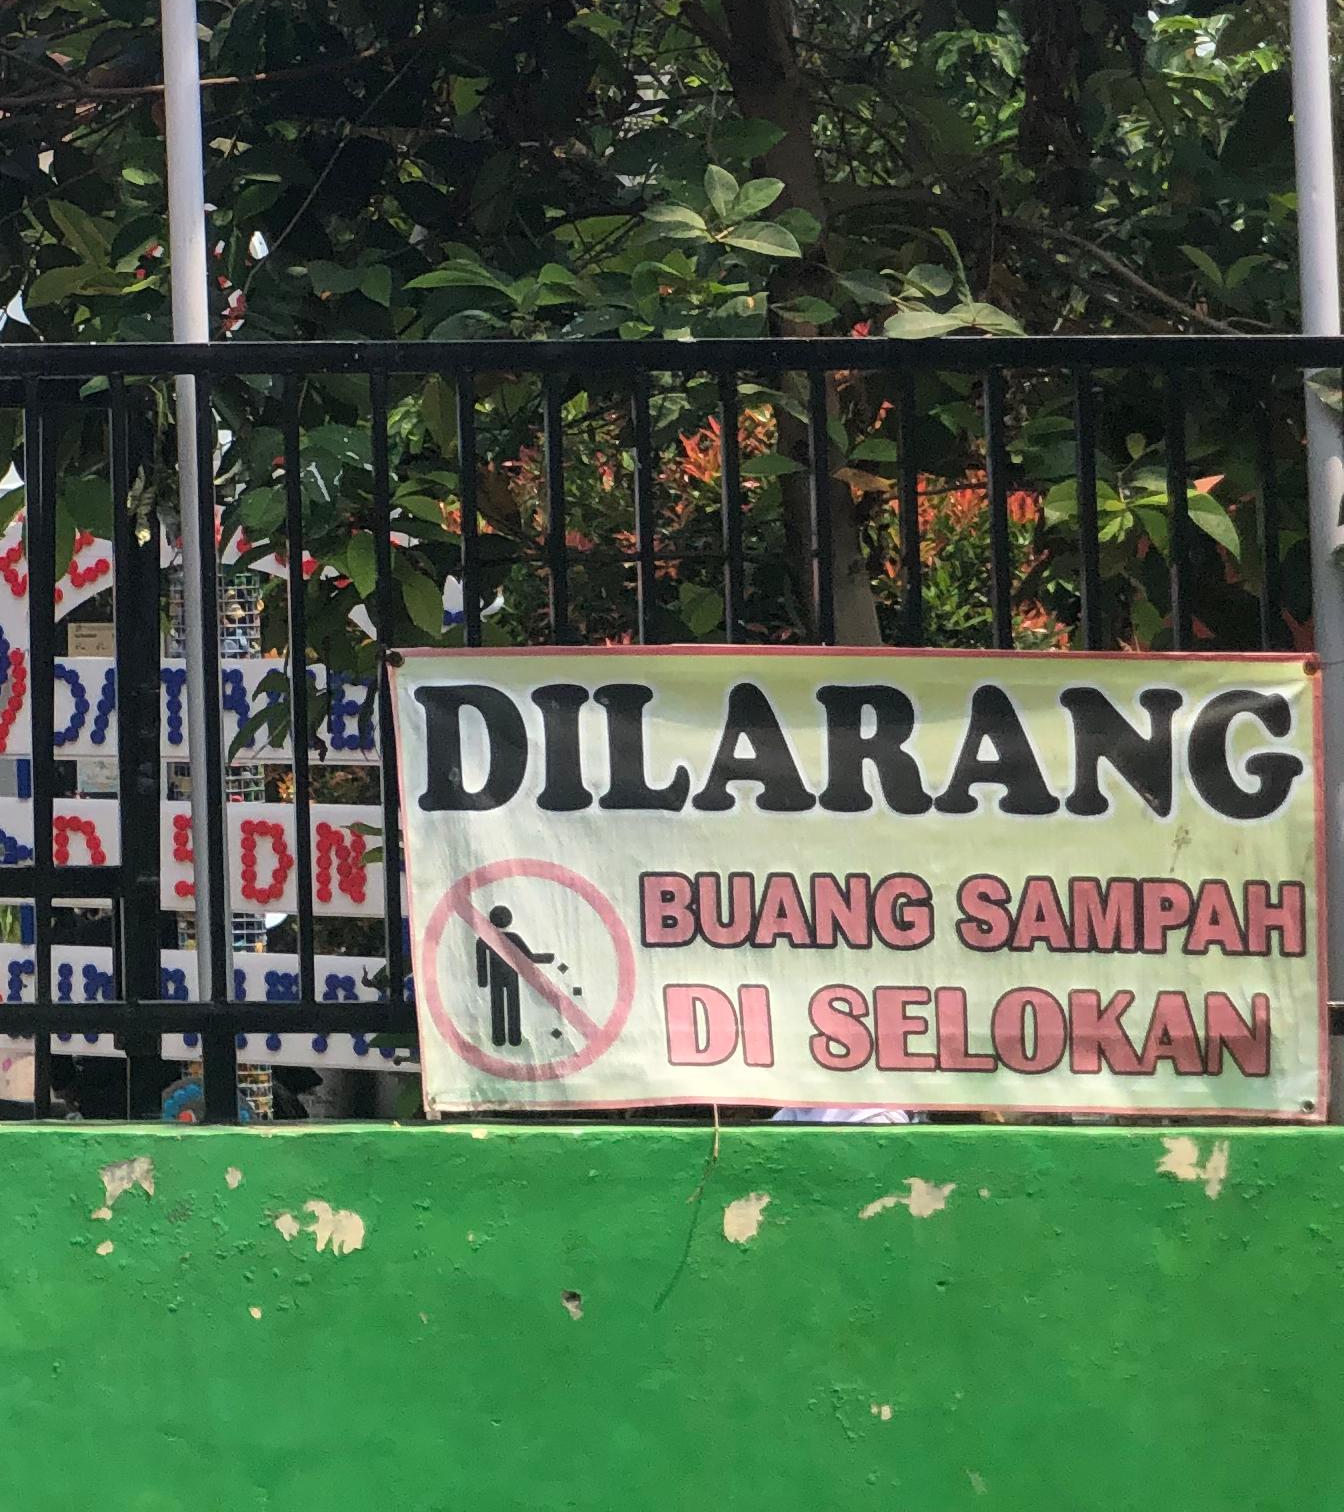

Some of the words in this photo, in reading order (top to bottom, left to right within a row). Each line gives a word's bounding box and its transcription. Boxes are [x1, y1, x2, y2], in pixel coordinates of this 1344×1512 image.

[414, 683, 1303, 819] DILARANG
[639, 872, 934, 951] BUANG
[955, 874, 1306, 958] SAMPAH
[664, 984, 775, 1068] DI
[810, 985, 1274, 1078] SELOKAN
